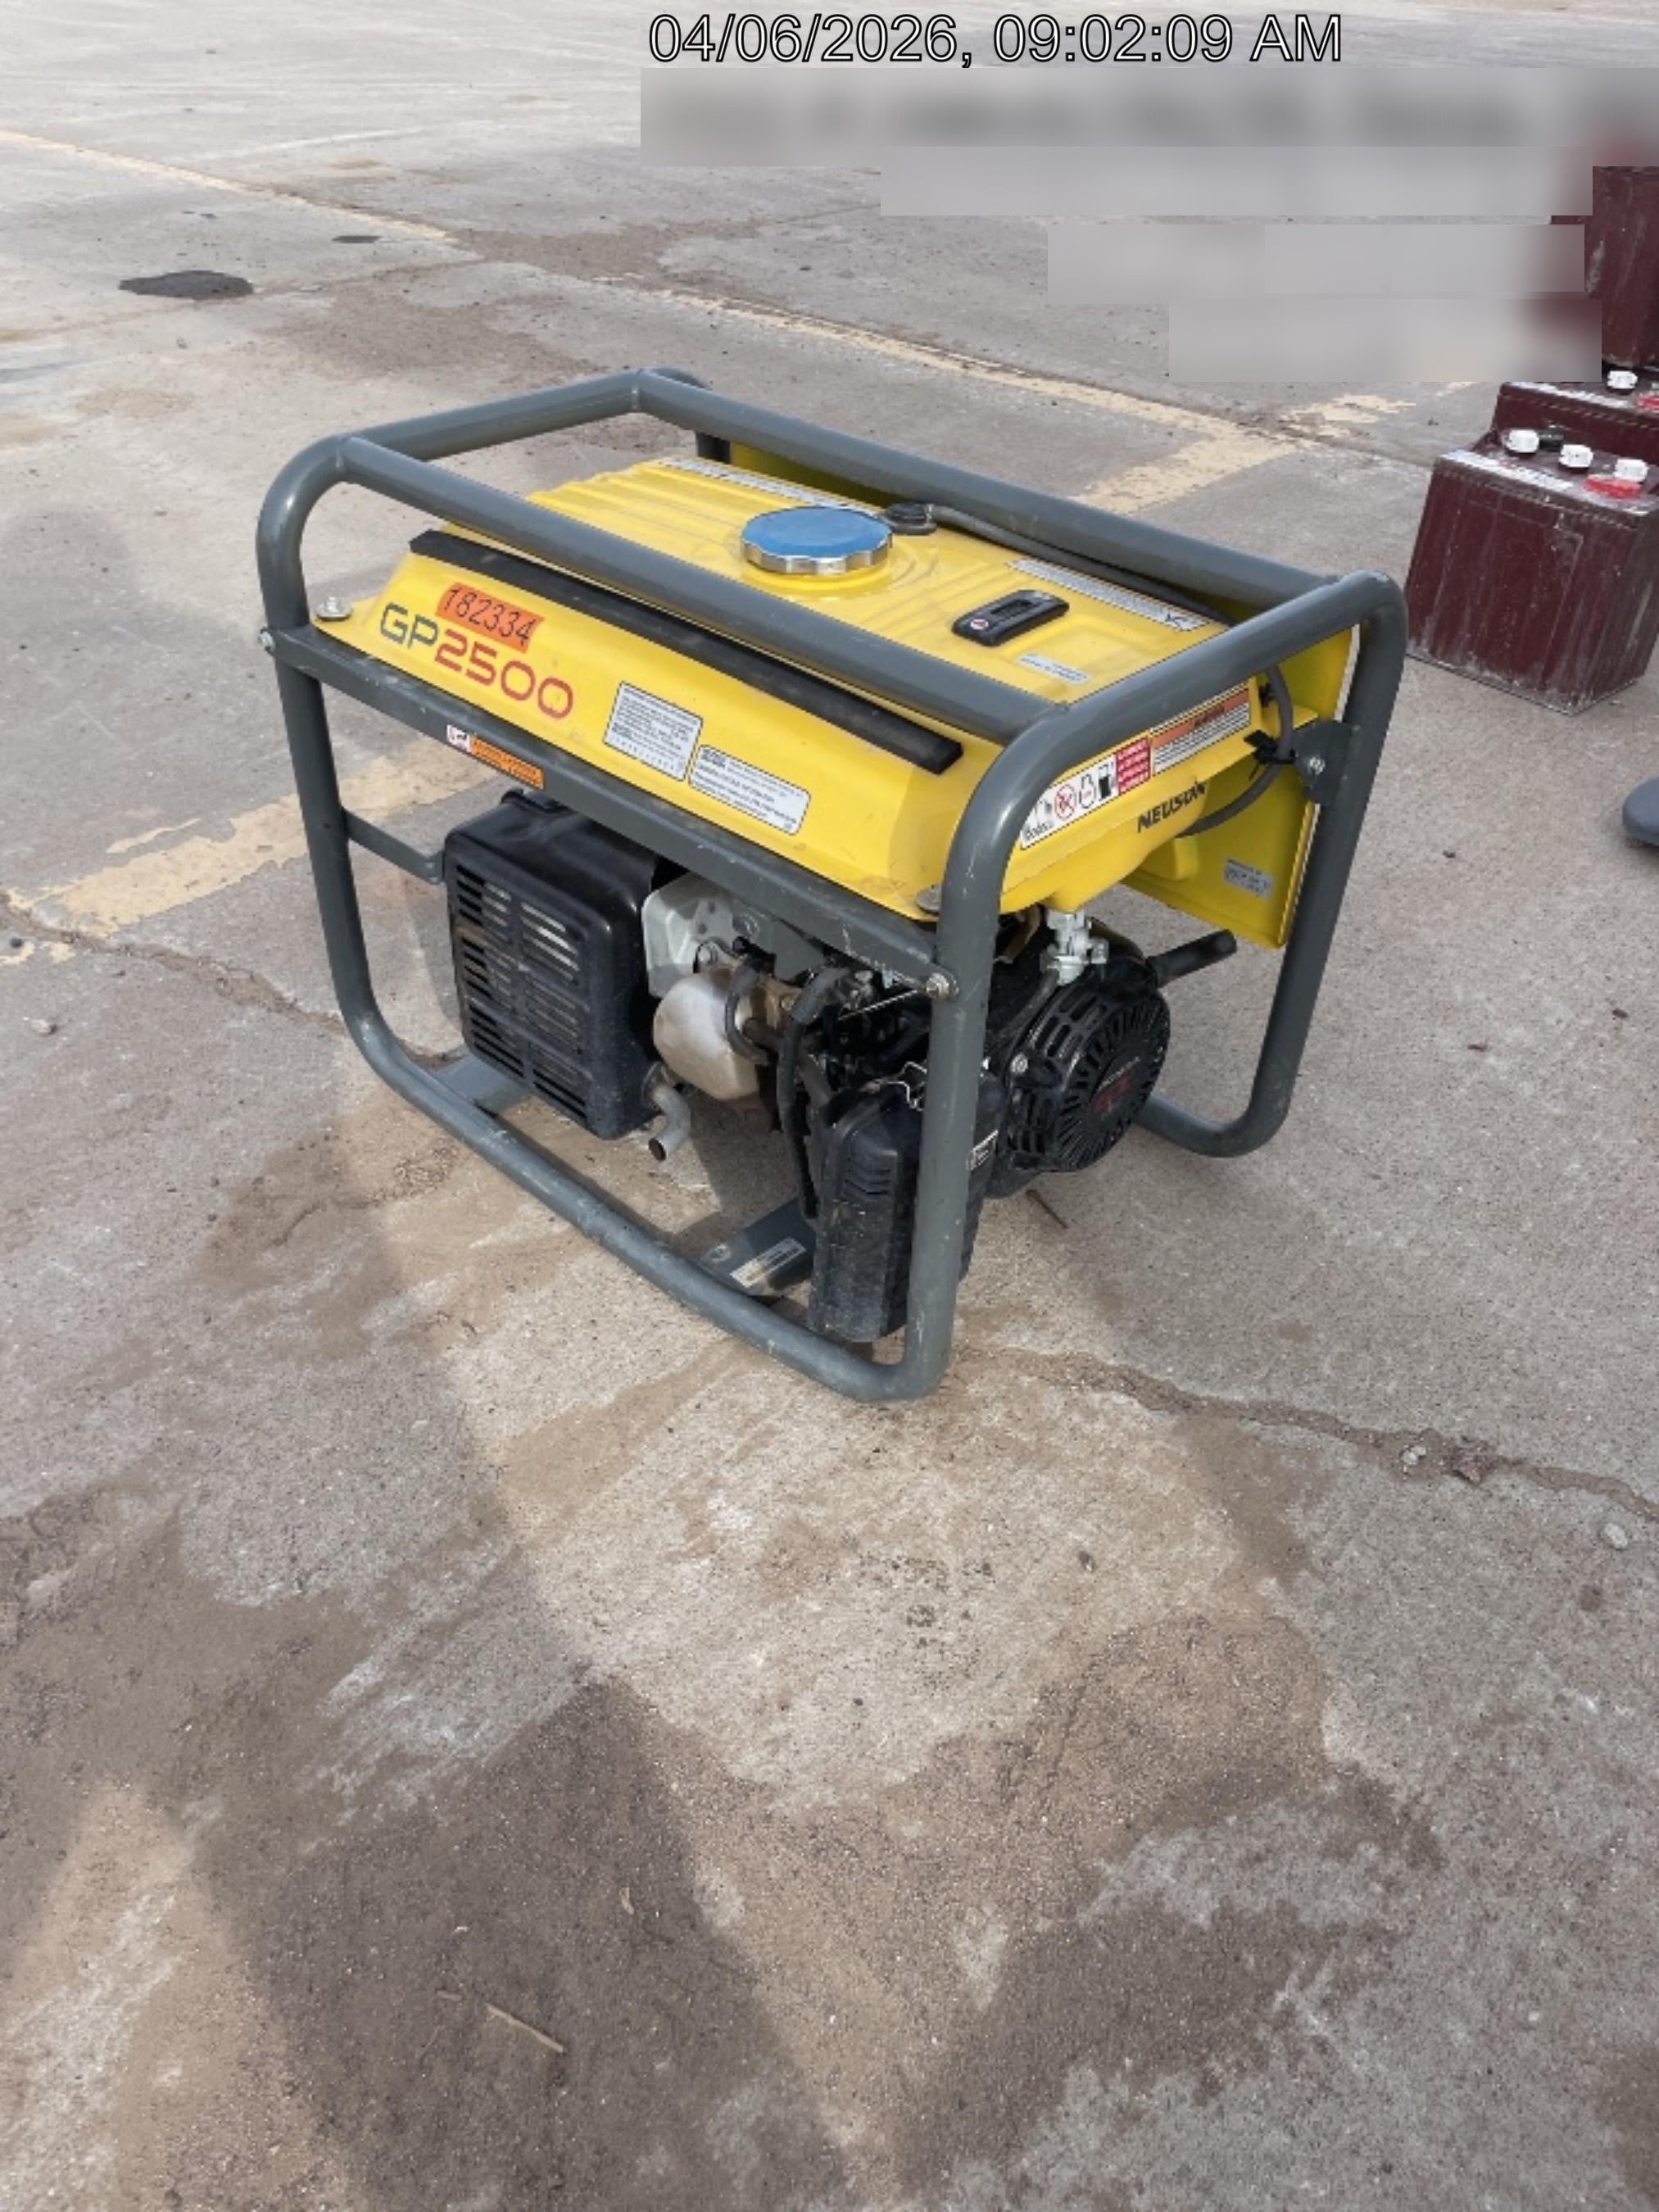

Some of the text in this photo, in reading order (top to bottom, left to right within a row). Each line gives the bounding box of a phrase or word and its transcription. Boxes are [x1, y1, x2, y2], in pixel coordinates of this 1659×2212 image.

[443, 586, 537, 646] 182334
[380, 602, 574, 719] GP2500
[1137, 778, 1206, 833] NEUSON
